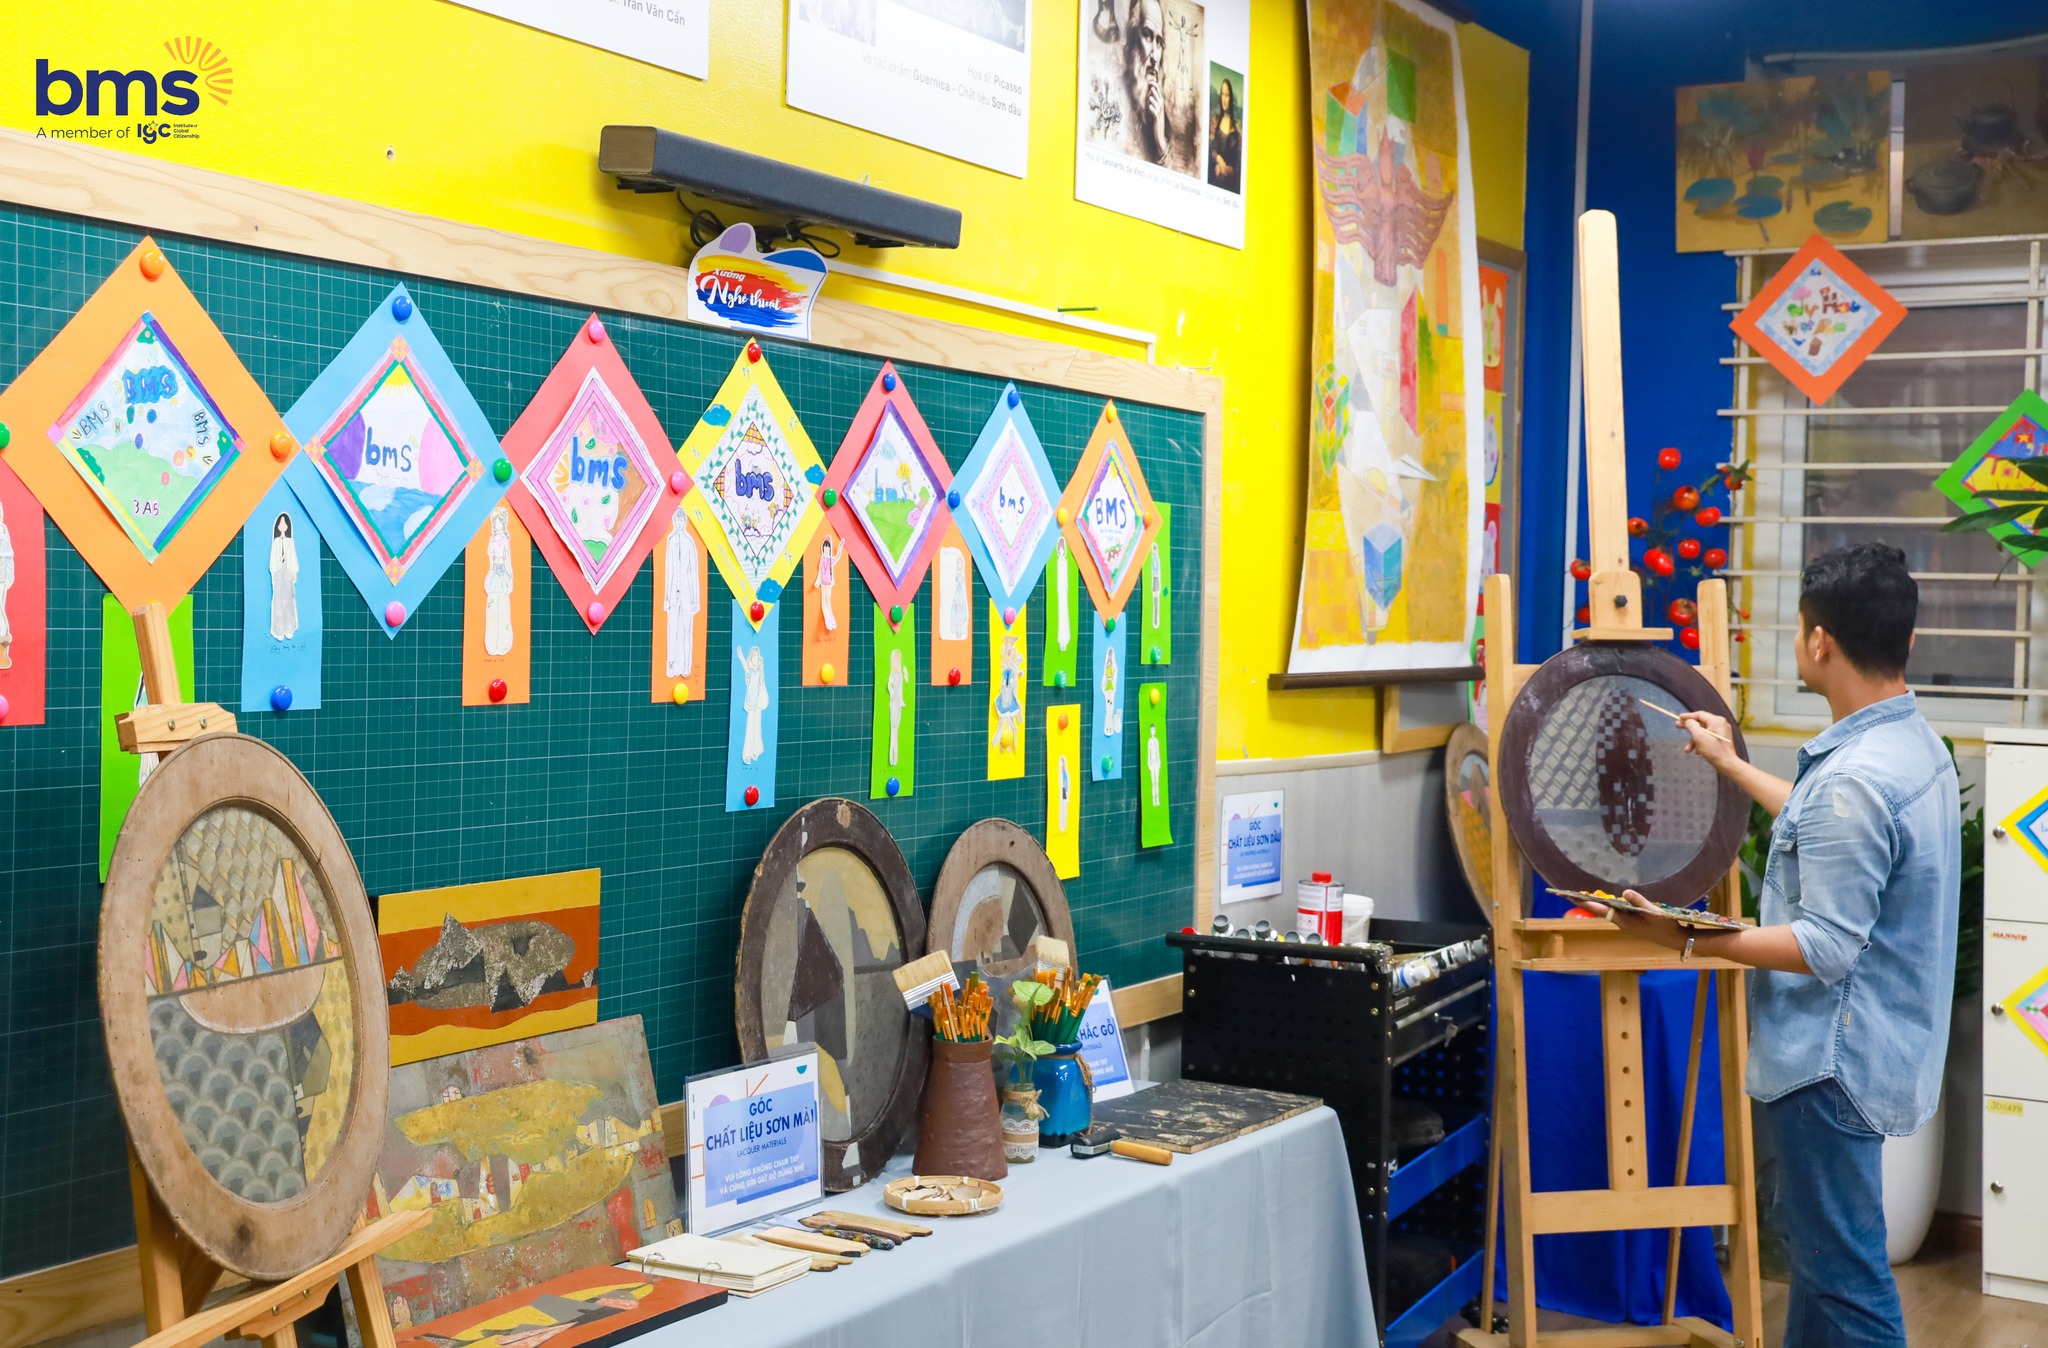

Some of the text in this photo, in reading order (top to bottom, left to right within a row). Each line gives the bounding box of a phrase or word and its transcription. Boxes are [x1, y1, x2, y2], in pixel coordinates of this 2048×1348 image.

[646, 2, 664, 19] Văn
[913, 69, 950, 92] Guernica
[991, 96, 1007, 111] Sơn
[1008, 102, 1022, 116] dầu
[994, 75, 1023, 95] Picasso
[1102, 156, 1125, 172] Leonardo
[126, 373, 174, 402] BMS
[79, 401, 112, 437] BMS
[192, 410, 212, 447] BMS
[365, 426, 412, 472] bms
[570, 435, 628, 490] bms
[734, 458, 775, 502] bms
[874, 467, 908, 506] bms
[999, 485, 1025, 515] bms
[1095, 497, 1127, 529] BMS
[1249, 819, 1261, 831] GÓC
[1228, 835, 1243, 849] CHẤT
[1243, 833, 1256, 848] LIỆU
[1256, 832, 1270, 846] SƠN
[1076, 1018, 1115, 1040] HẮC GỖ
[749, 1096, 773, 1116] GÓC
[706, 1106, 815, 1151] CHẤT LIỆU SƠN MÀI
[737, 1137, 787, 1157] LACQUER MATERIALS
[724, 1174, 735, 1182] VUI
[735, 1168, 751, 1179] LÒNG
[752, 1161, 773, 1175] KHÔNG
[789, 1155, 800, 1164] TAY
[719, 1184, 729, 1195] VÀ
[729, 1180, 745, 1193] CÙNG
